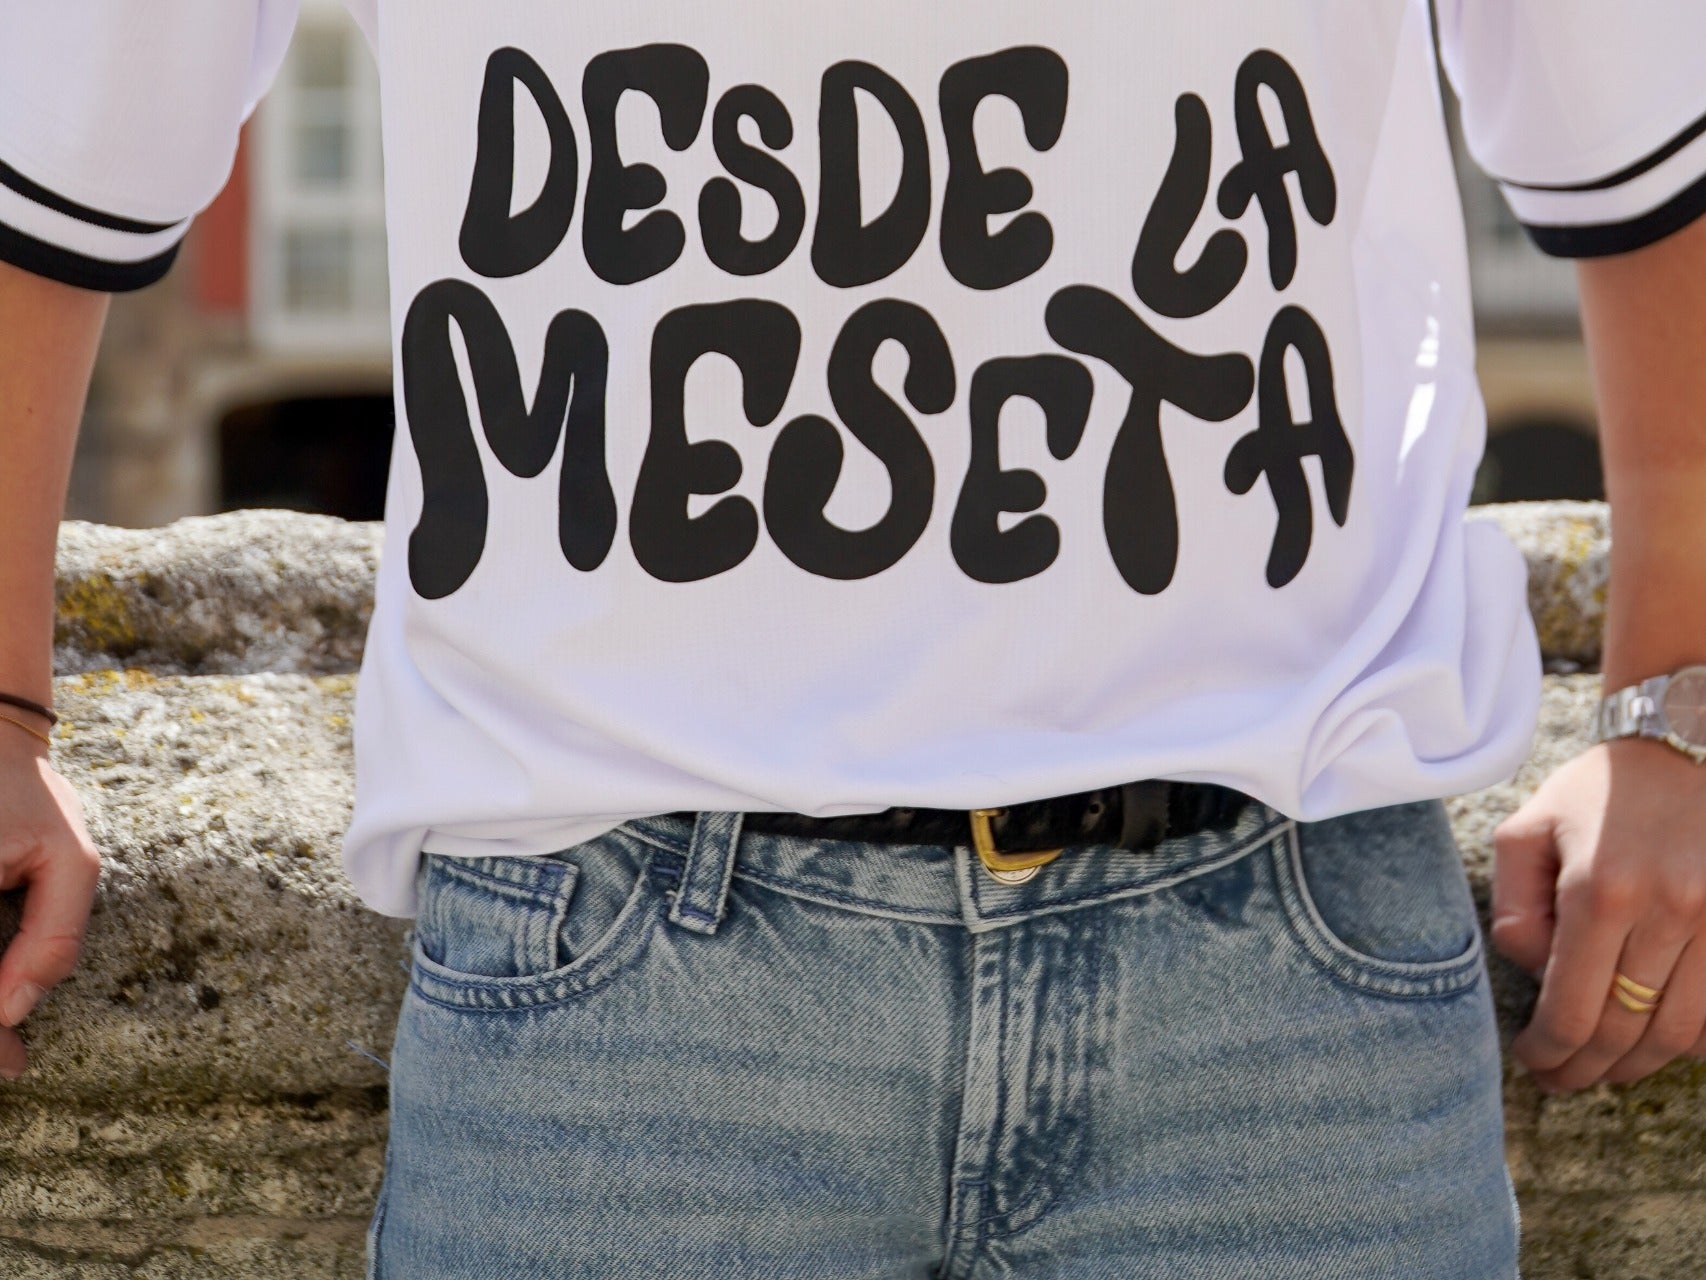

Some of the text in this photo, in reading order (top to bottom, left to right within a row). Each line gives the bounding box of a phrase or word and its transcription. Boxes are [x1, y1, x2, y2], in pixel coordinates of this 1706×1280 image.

[459, 44, 1336, 318] DESDE LA
[402, 279, 1354, 600] MESETA
